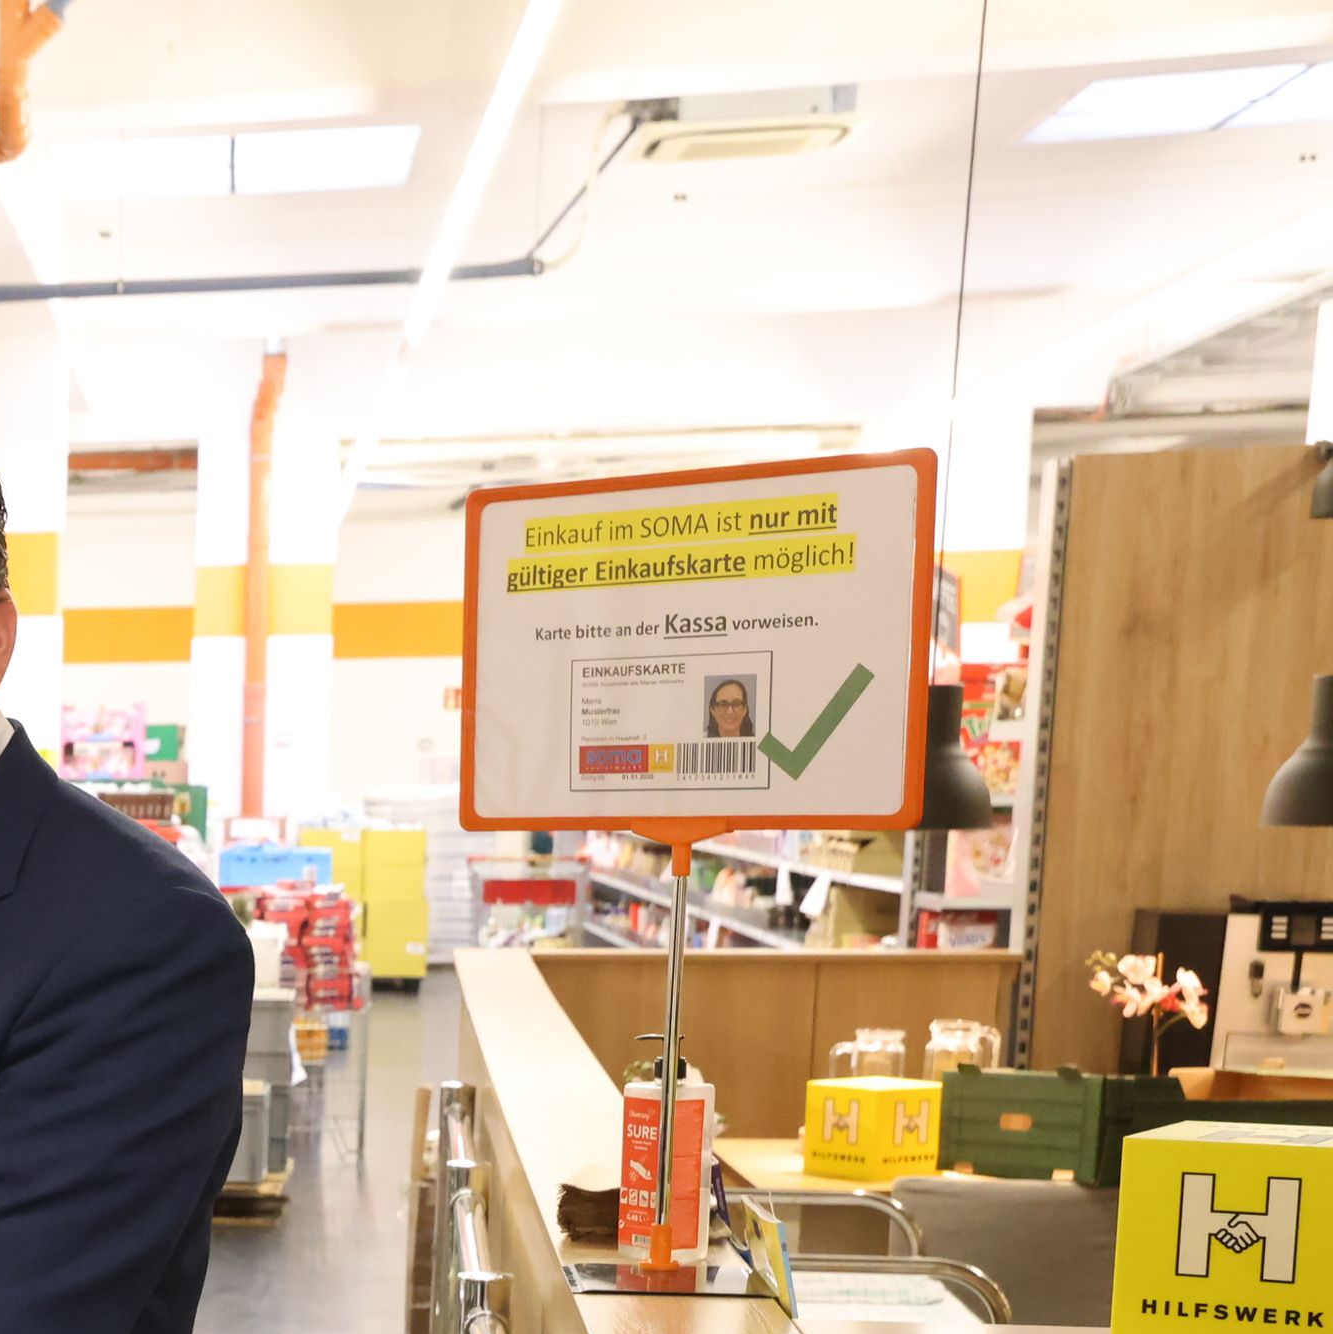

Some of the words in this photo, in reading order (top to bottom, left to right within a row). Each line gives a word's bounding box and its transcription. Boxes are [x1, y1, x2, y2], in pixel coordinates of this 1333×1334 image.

[525, 520, 604, 548] Einkauf
[608, 520, 633, 541] im
[640, 513, 709, 539] SOMA
[716, 511, 742, 533] ist
[749, 509, 790, 532] nur
[797, 503, 838, 528] mit
[507, 563, 588, 593] gültiger
[595, 551, 746, 583] Einkaufskarte
[753, 541, 855, 575] möglich!
[535, 627, 572, 642] Karte
[575, 624, 612, 640] bitte
[615, 626, 633, 638] an
[635, 622, 660, 637] der
[664, 613, 728, 636] Kassa
[732, 613, 820, 632] vorweisen.
[582, 663, 686, 678] EINKAUFSKARTE
[626, 1123, 658, 1140] SURE
[1141, 1299, 1325, 1328] HILFSWERK
